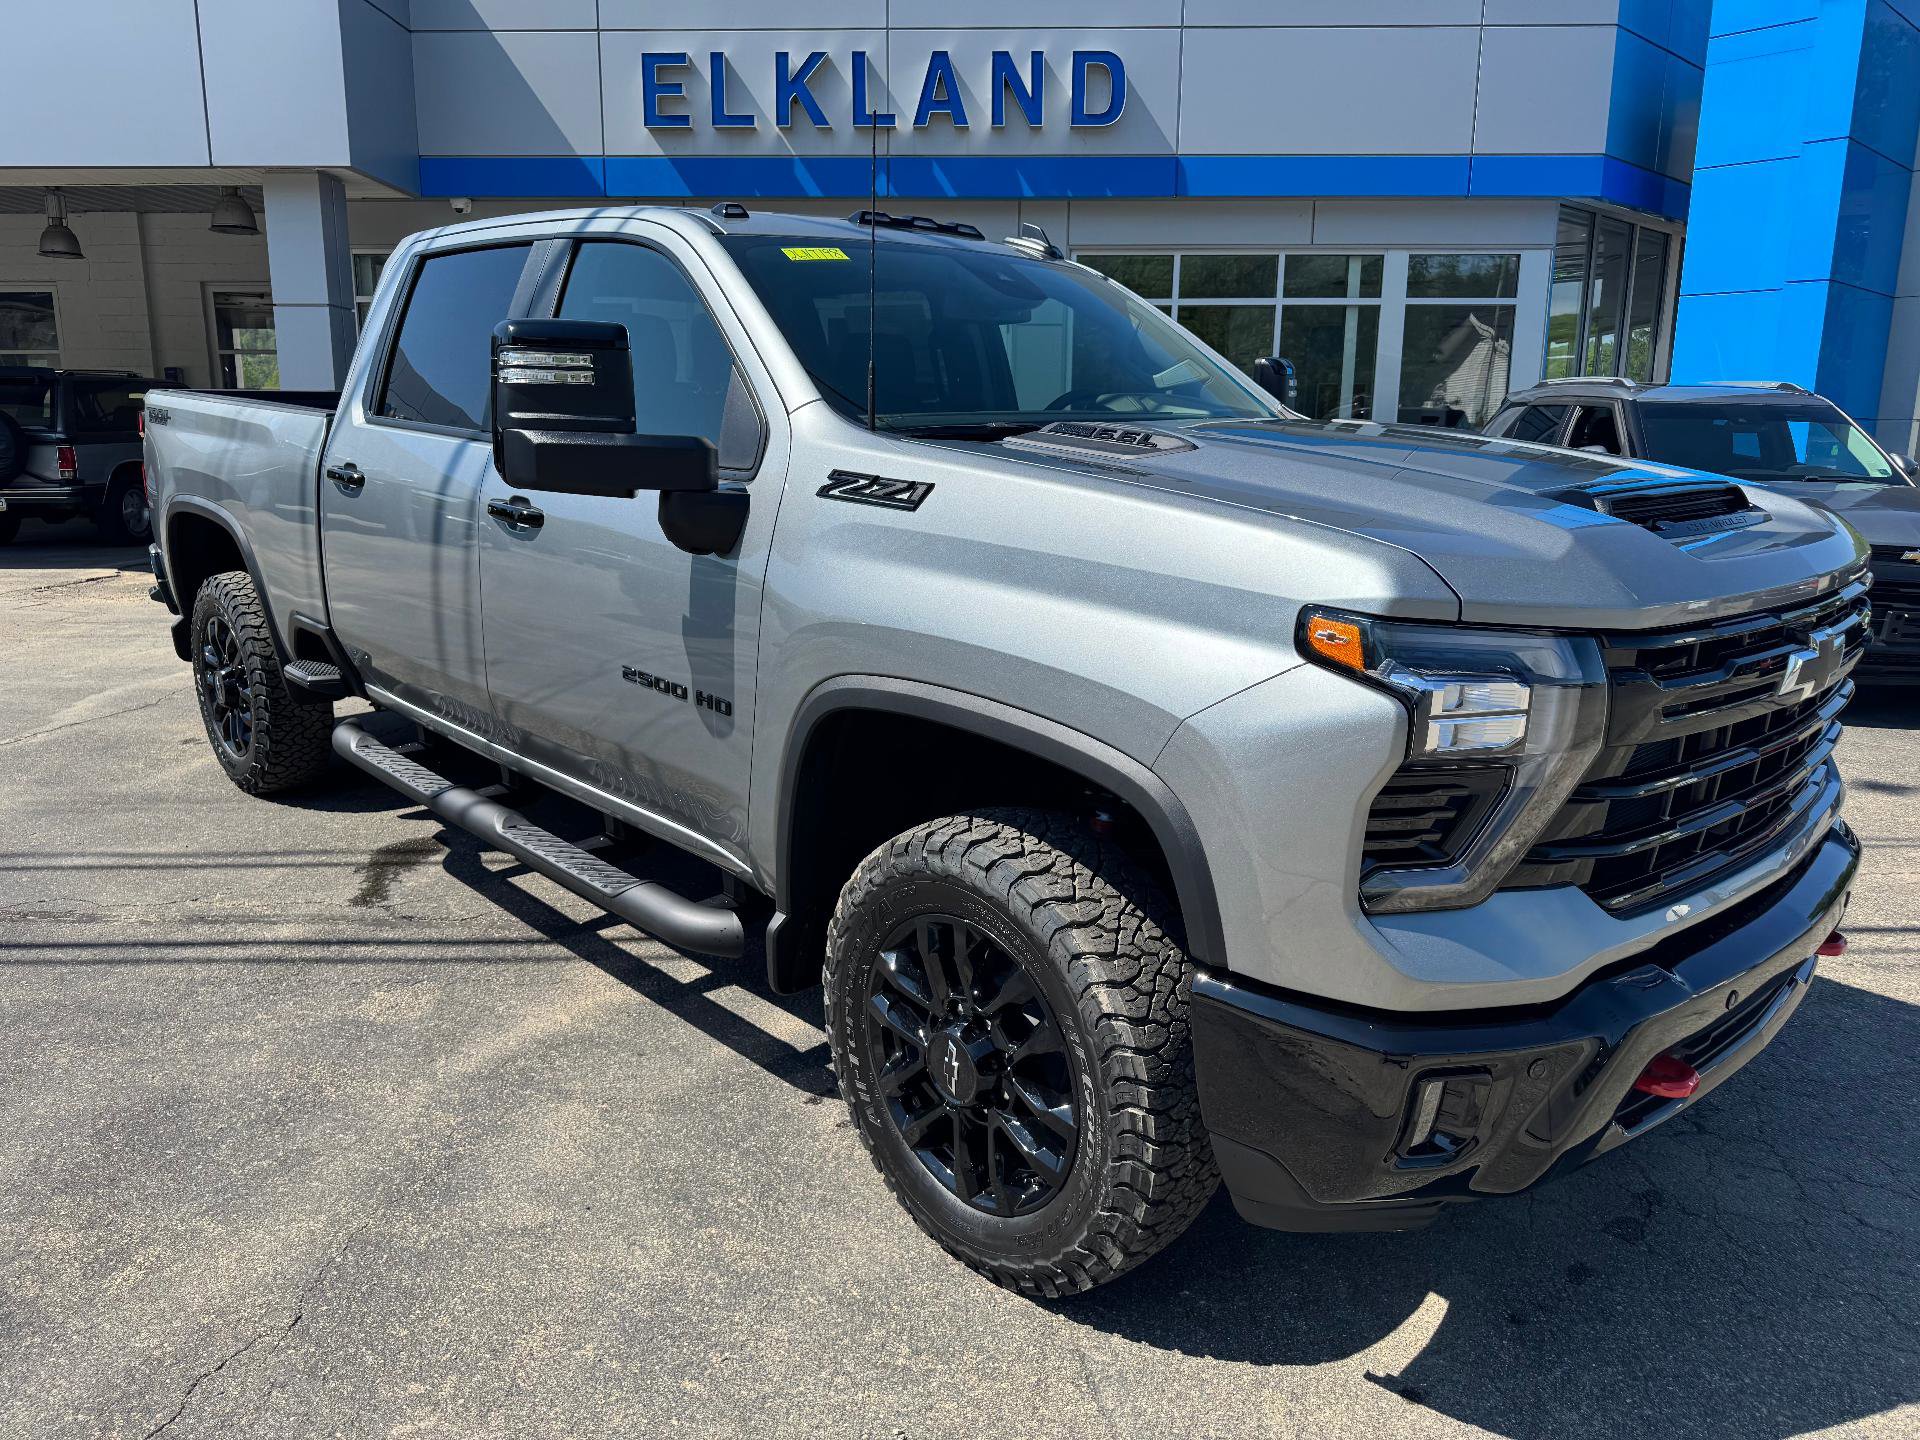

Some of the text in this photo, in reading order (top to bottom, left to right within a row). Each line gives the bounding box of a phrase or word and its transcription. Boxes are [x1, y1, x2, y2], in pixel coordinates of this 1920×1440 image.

[641, 50, 1127, 128] ELKLAND
[815, 468, 936, 512] Z71
[622, 664, 732, 717] 2500 HD
